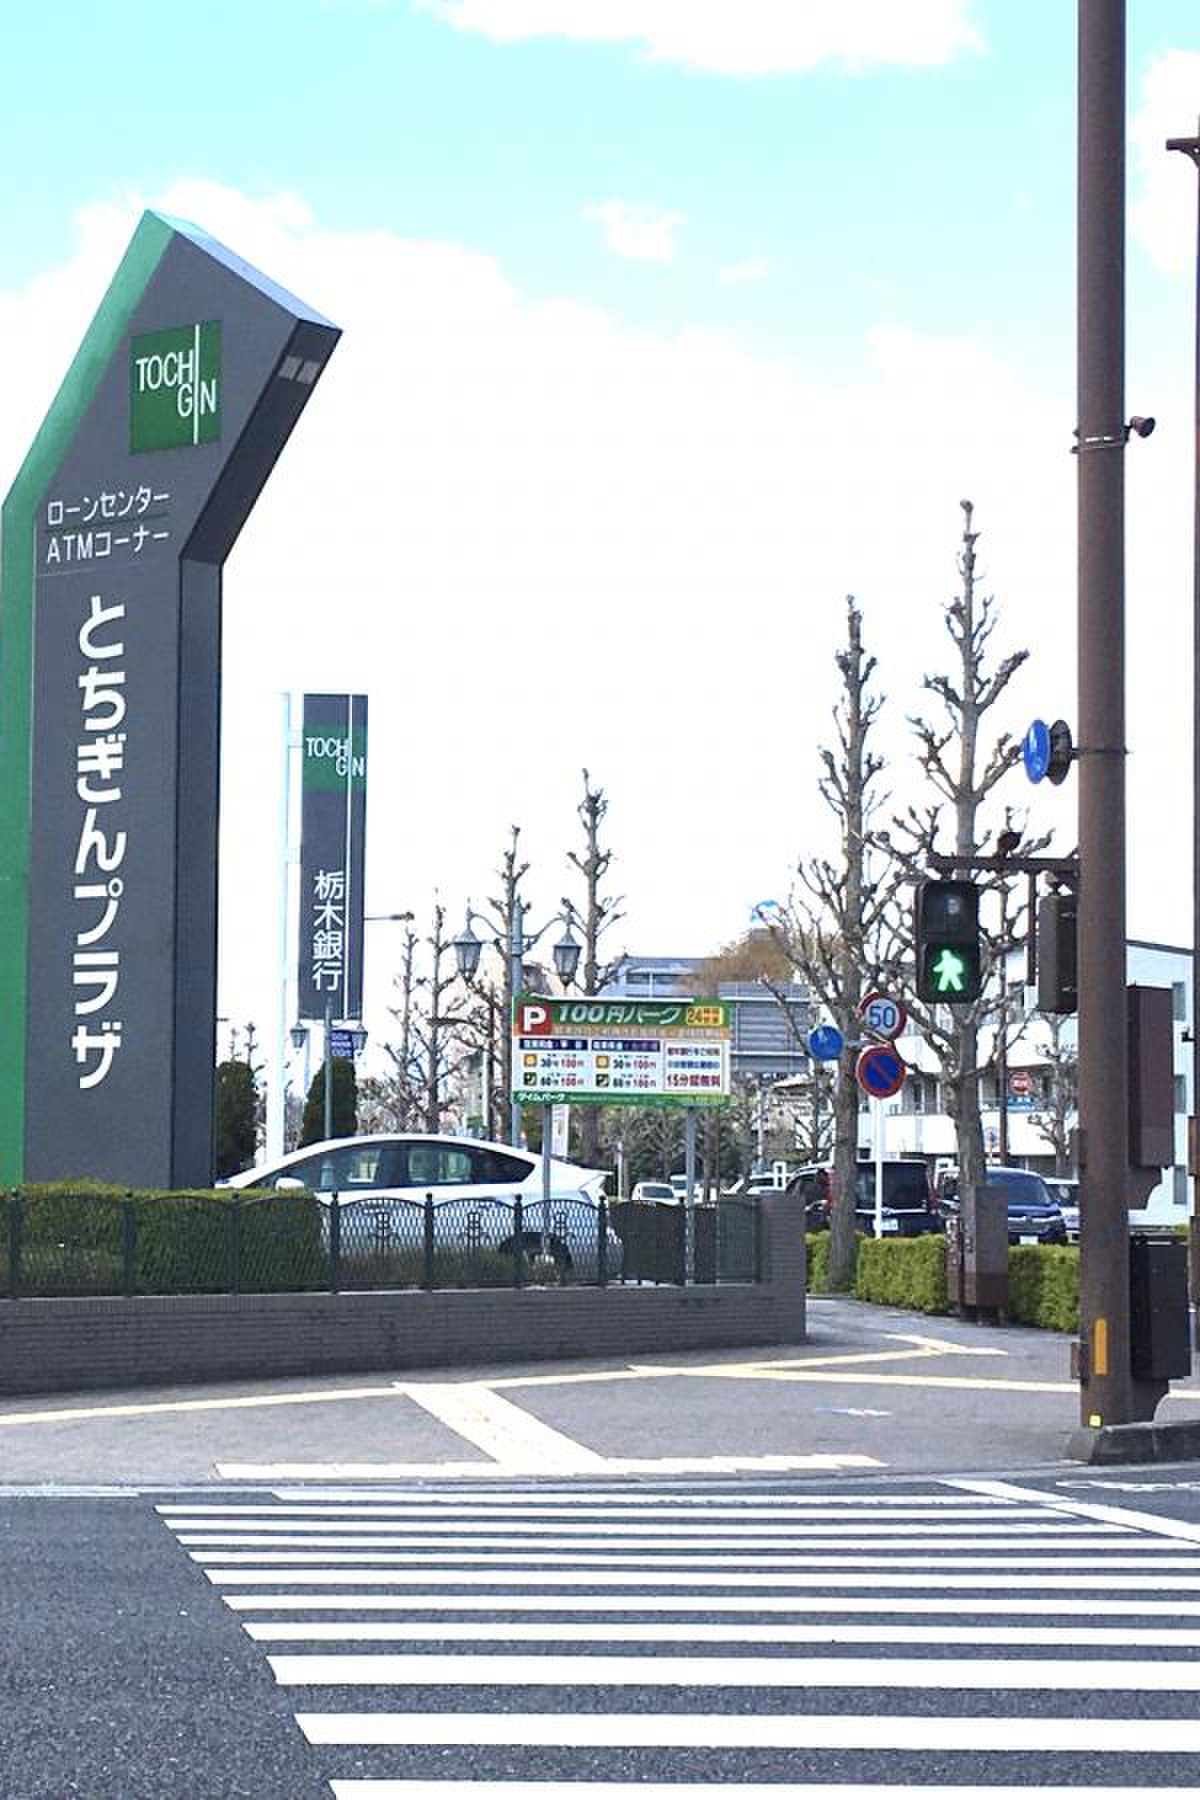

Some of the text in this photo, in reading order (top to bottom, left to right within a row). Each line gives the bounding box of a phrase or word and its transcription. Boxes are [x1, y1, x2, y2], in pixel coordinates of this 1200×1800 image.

[47, 486, 170, 525] ローンセンター
[46, 525, 170, 563] ATMコーナー
[71, 595, 128, 1089] とちぎんプラザ
[312, 869, 344, 991] 栃木銀行
[523, 1006, 546, 1032] P
[559, 1005, 681, 1024] 100円パーク
[869, 1006, 895, 1029] 50
